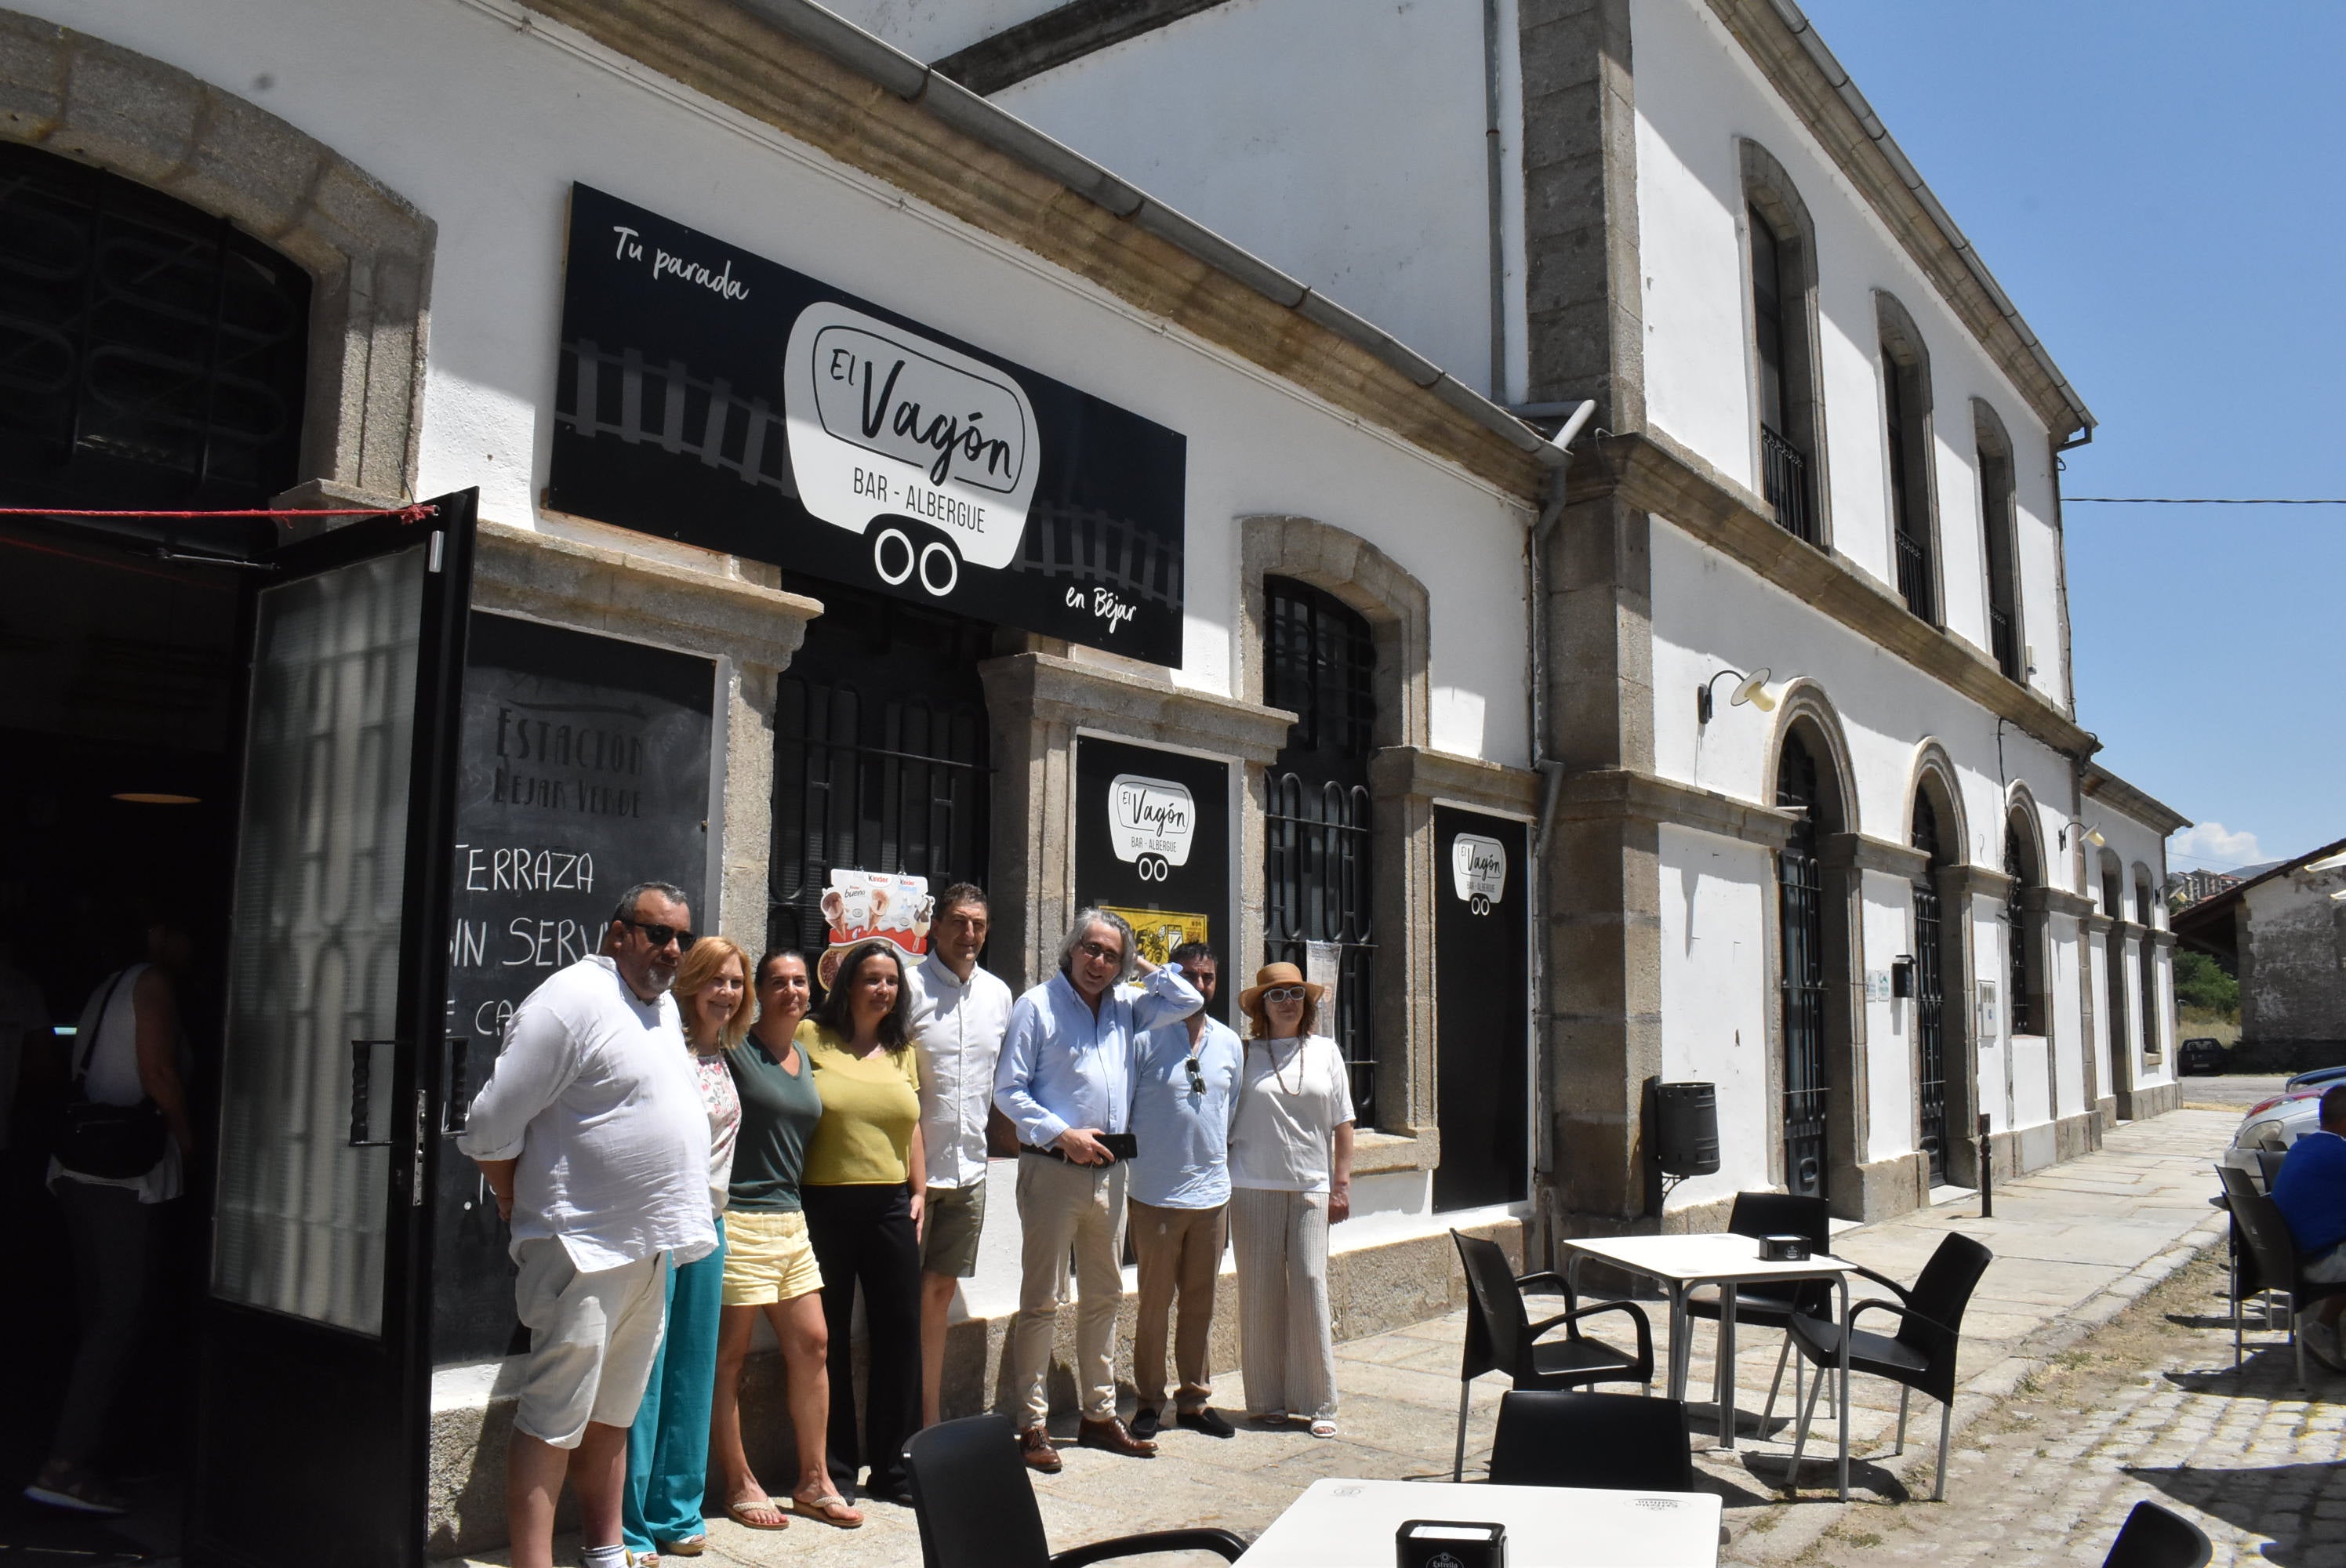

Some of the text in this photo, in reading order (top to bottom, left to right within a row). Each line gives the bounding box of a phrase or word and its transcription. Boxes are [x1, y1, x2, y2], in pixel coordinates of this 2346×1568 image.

[613, 226, 750, 300] Tu parada
[830, 349, 1011, 487] El Vagón
[853, 466, 888, 503] BAR
[906, 485, 986, 534] ALBERGUE
[1066, 586, 1137, 633] en Béjar
[1123, 789, 1186, 837] El Vagón
[1131, 836, 1143, 849] BAR
[1149, 838, 1177, 853] ALBERGUE
[1468, 844, 1501, 881] Vagón
[449, 916, 608, 967] IN SERV
